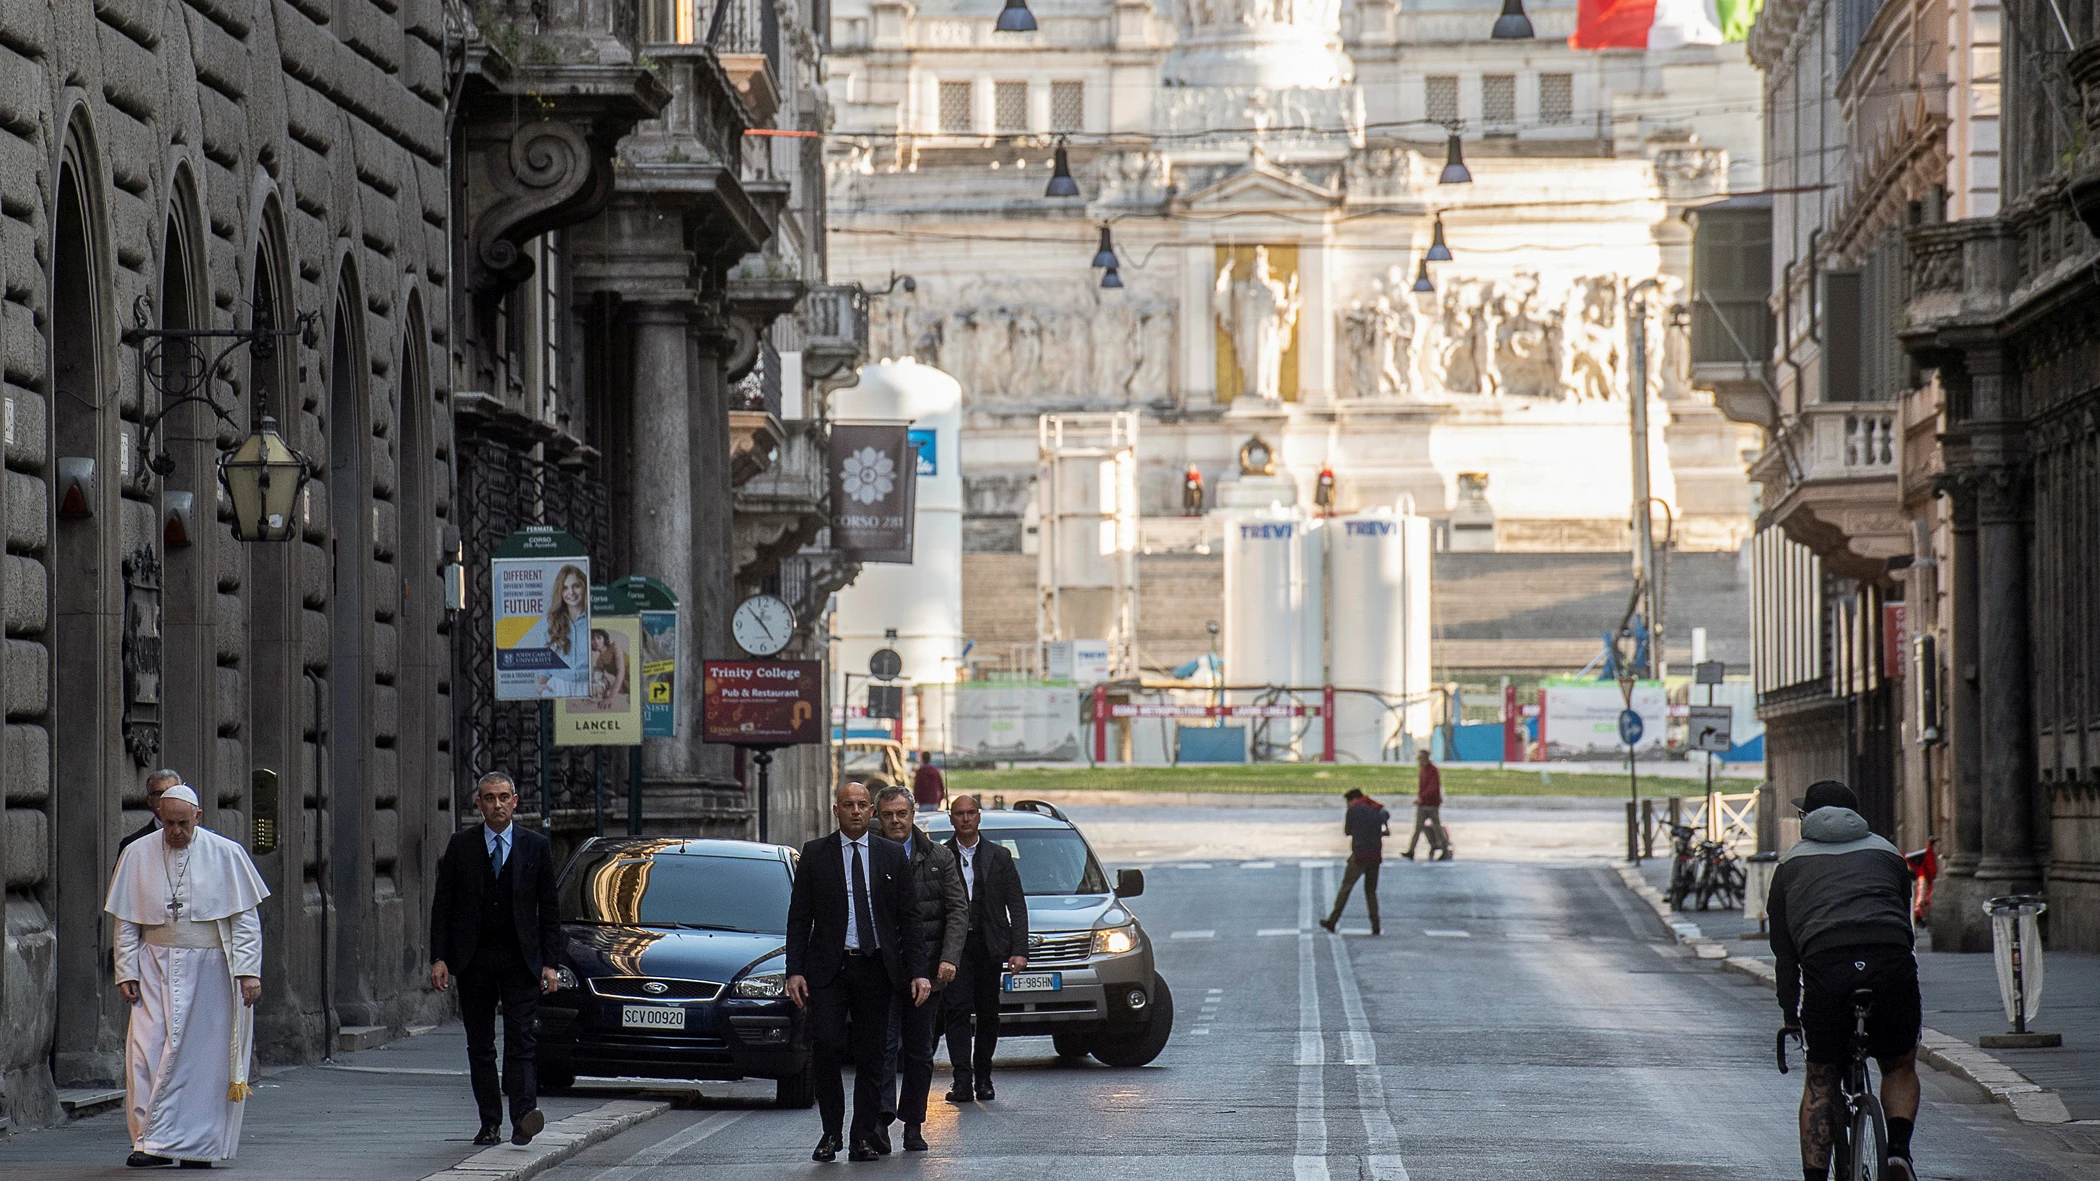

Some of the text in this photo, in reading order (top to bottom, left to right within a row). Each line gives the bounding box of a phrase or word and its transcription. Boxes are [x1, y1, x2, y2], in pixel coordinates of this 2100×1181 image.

[1240, 525, 1292, 539] TREVI
[1345, 521, 1397, 536] TREVI
[503, 570, 543, 581] DIFFERENT
[503, 599, 544, 613] FUTURE
[757, 597, 769, 608] 12
[735, 620, 743, 630] 9
[759, 643, 767, 652] 6
[710, 667, 801, 681] Trinity College
[722, 688, 799, 698] Pub & Restaurant
[575, 720, 621, 731] LANCEL
